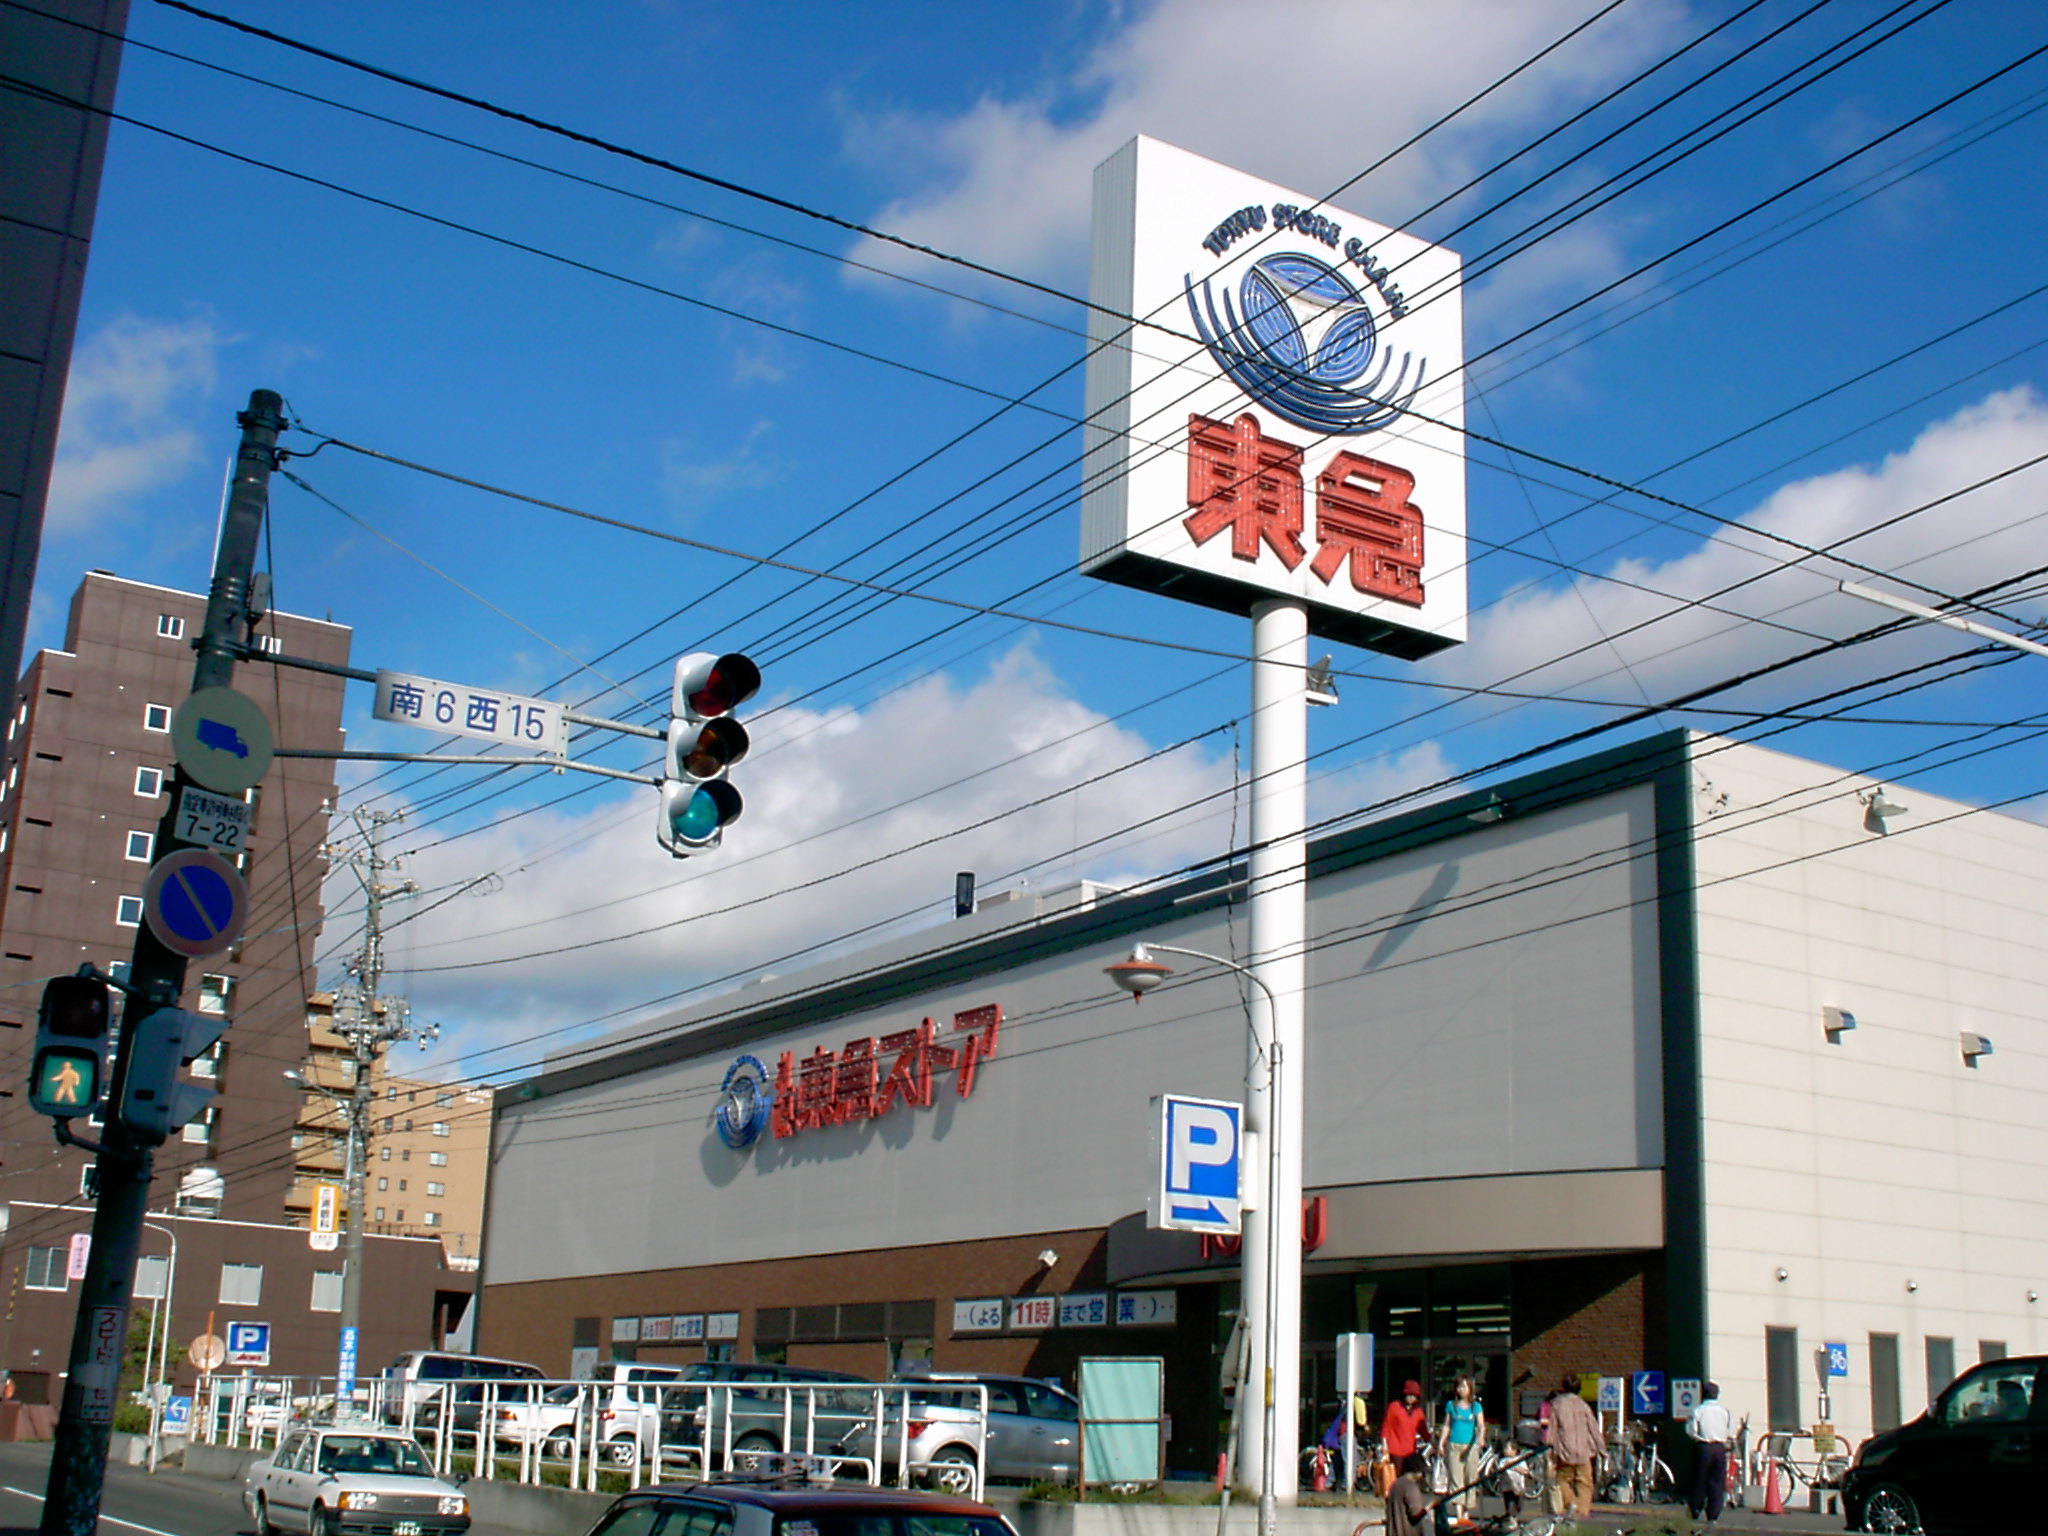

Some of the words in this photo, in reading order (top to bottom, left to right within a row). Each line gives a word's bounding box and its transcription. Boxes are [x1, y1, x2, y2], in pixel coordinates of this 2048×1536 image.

[1202, 204, 1267, 258] TOKYU
[1271, 203, 1342, 250] STORE
[1183, 411, 1425, 609] 東急
[390, 682, 546, 741] 南6西15
[186, 814, 240, 847] 7-22
[1171, 1103, 1235, 1190] P
[236, 1327, 260, 1349] P
